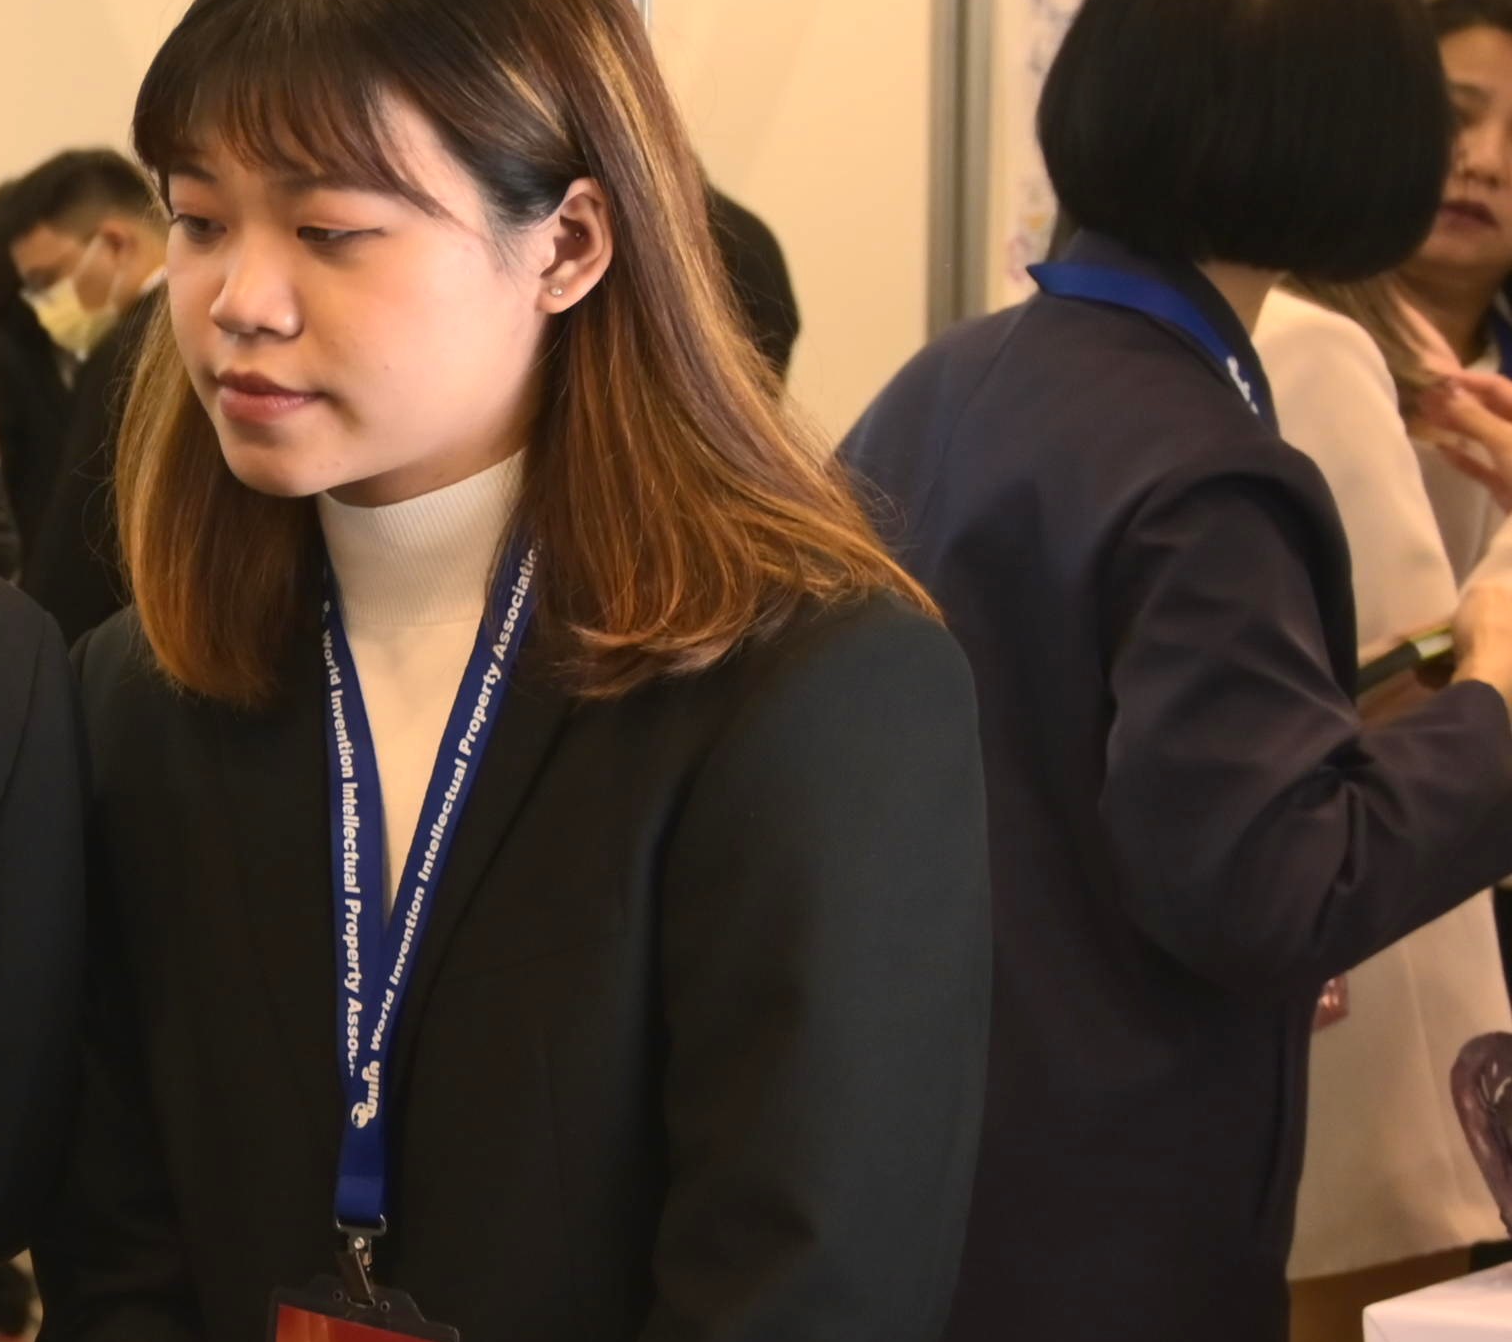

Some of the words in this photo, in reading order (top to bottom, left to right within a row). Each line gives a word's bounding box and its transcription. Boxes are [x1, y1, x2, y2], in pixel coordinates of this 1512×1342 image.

[330, 689, 355, 781] Invention
[341, 781, 361, 894] Intellectual
[370, 989, 396, 1051] World
[389, 885, 425, 986] Invention
[420, 759, 469, 885] Intellectual
[457, 660, 503, 757] Property
[342, 898, 362, 994] Property
